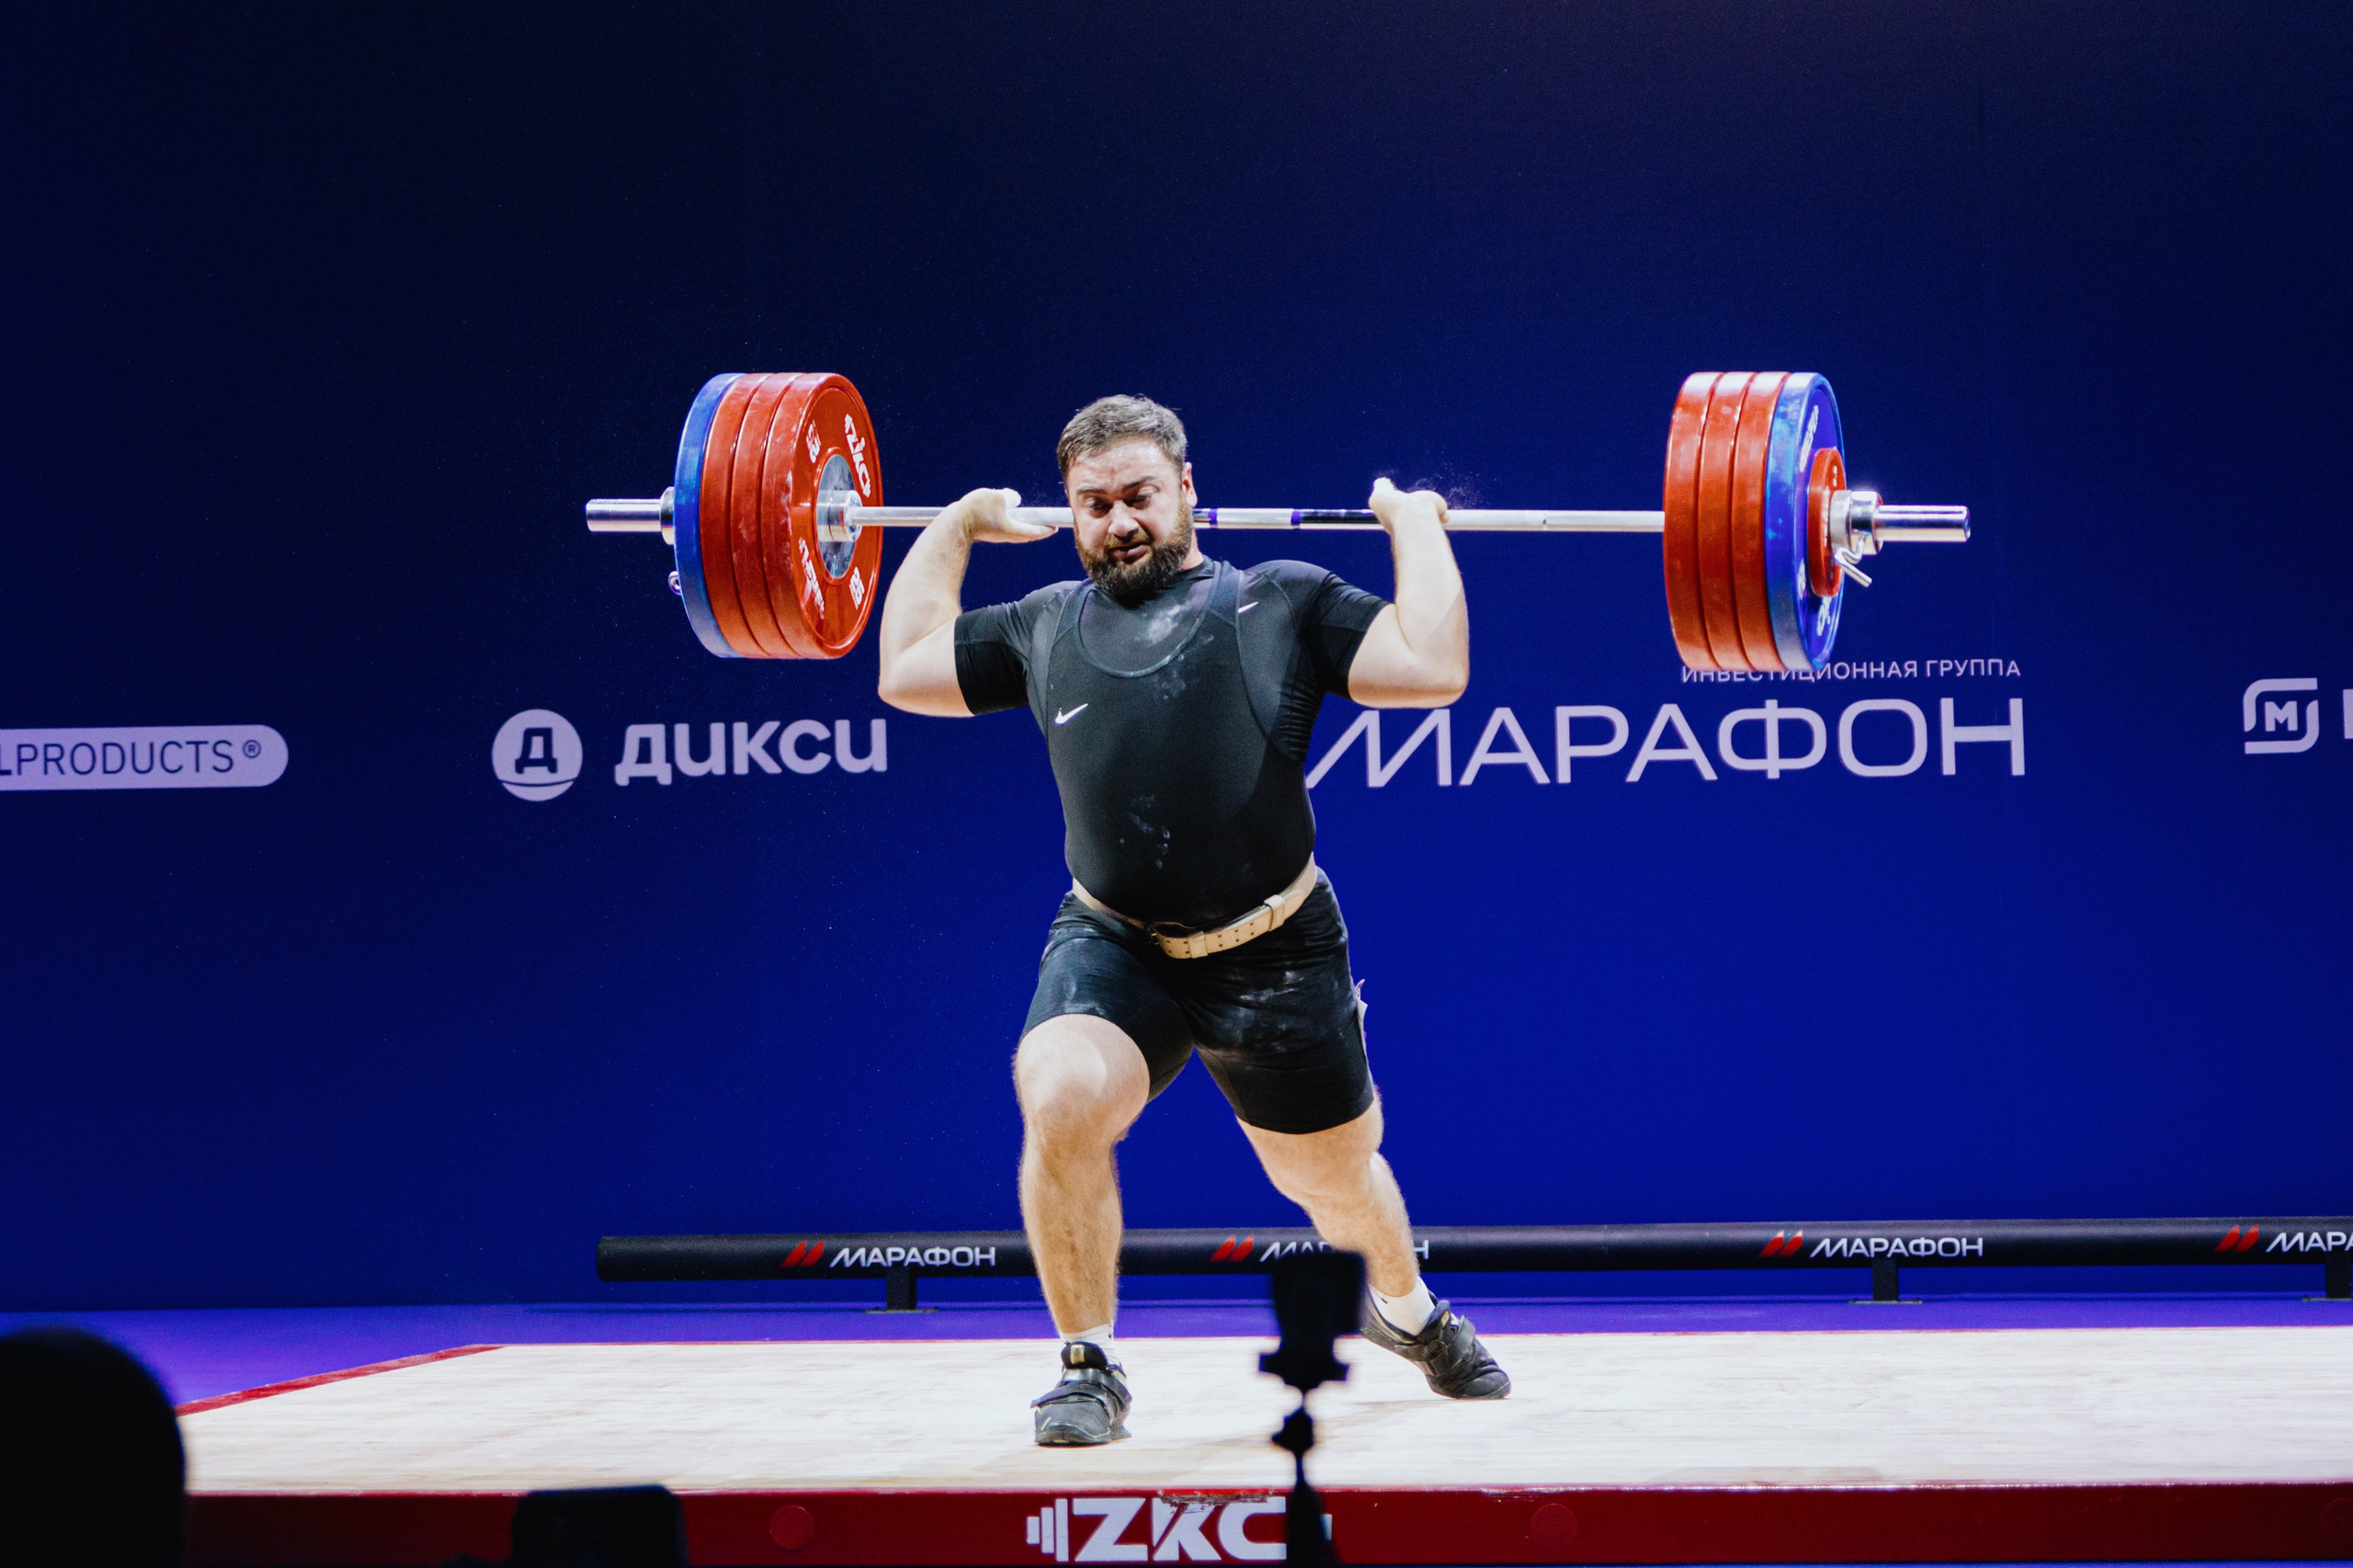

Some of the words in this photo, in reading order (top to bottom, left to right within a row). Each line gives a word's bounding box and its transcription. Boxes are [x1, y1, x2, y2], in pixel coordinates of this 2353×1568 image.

[1926, 658, 2021, 677] ГРУППА
[1306, 698, 2026, 789] МАРАФОН
[829, 1246, 996, 1268] МАРАФОН
[1809, 1237, 1984, 1258] МАРАФОН
[1073, 1495, 1287, 1562] ZKC
